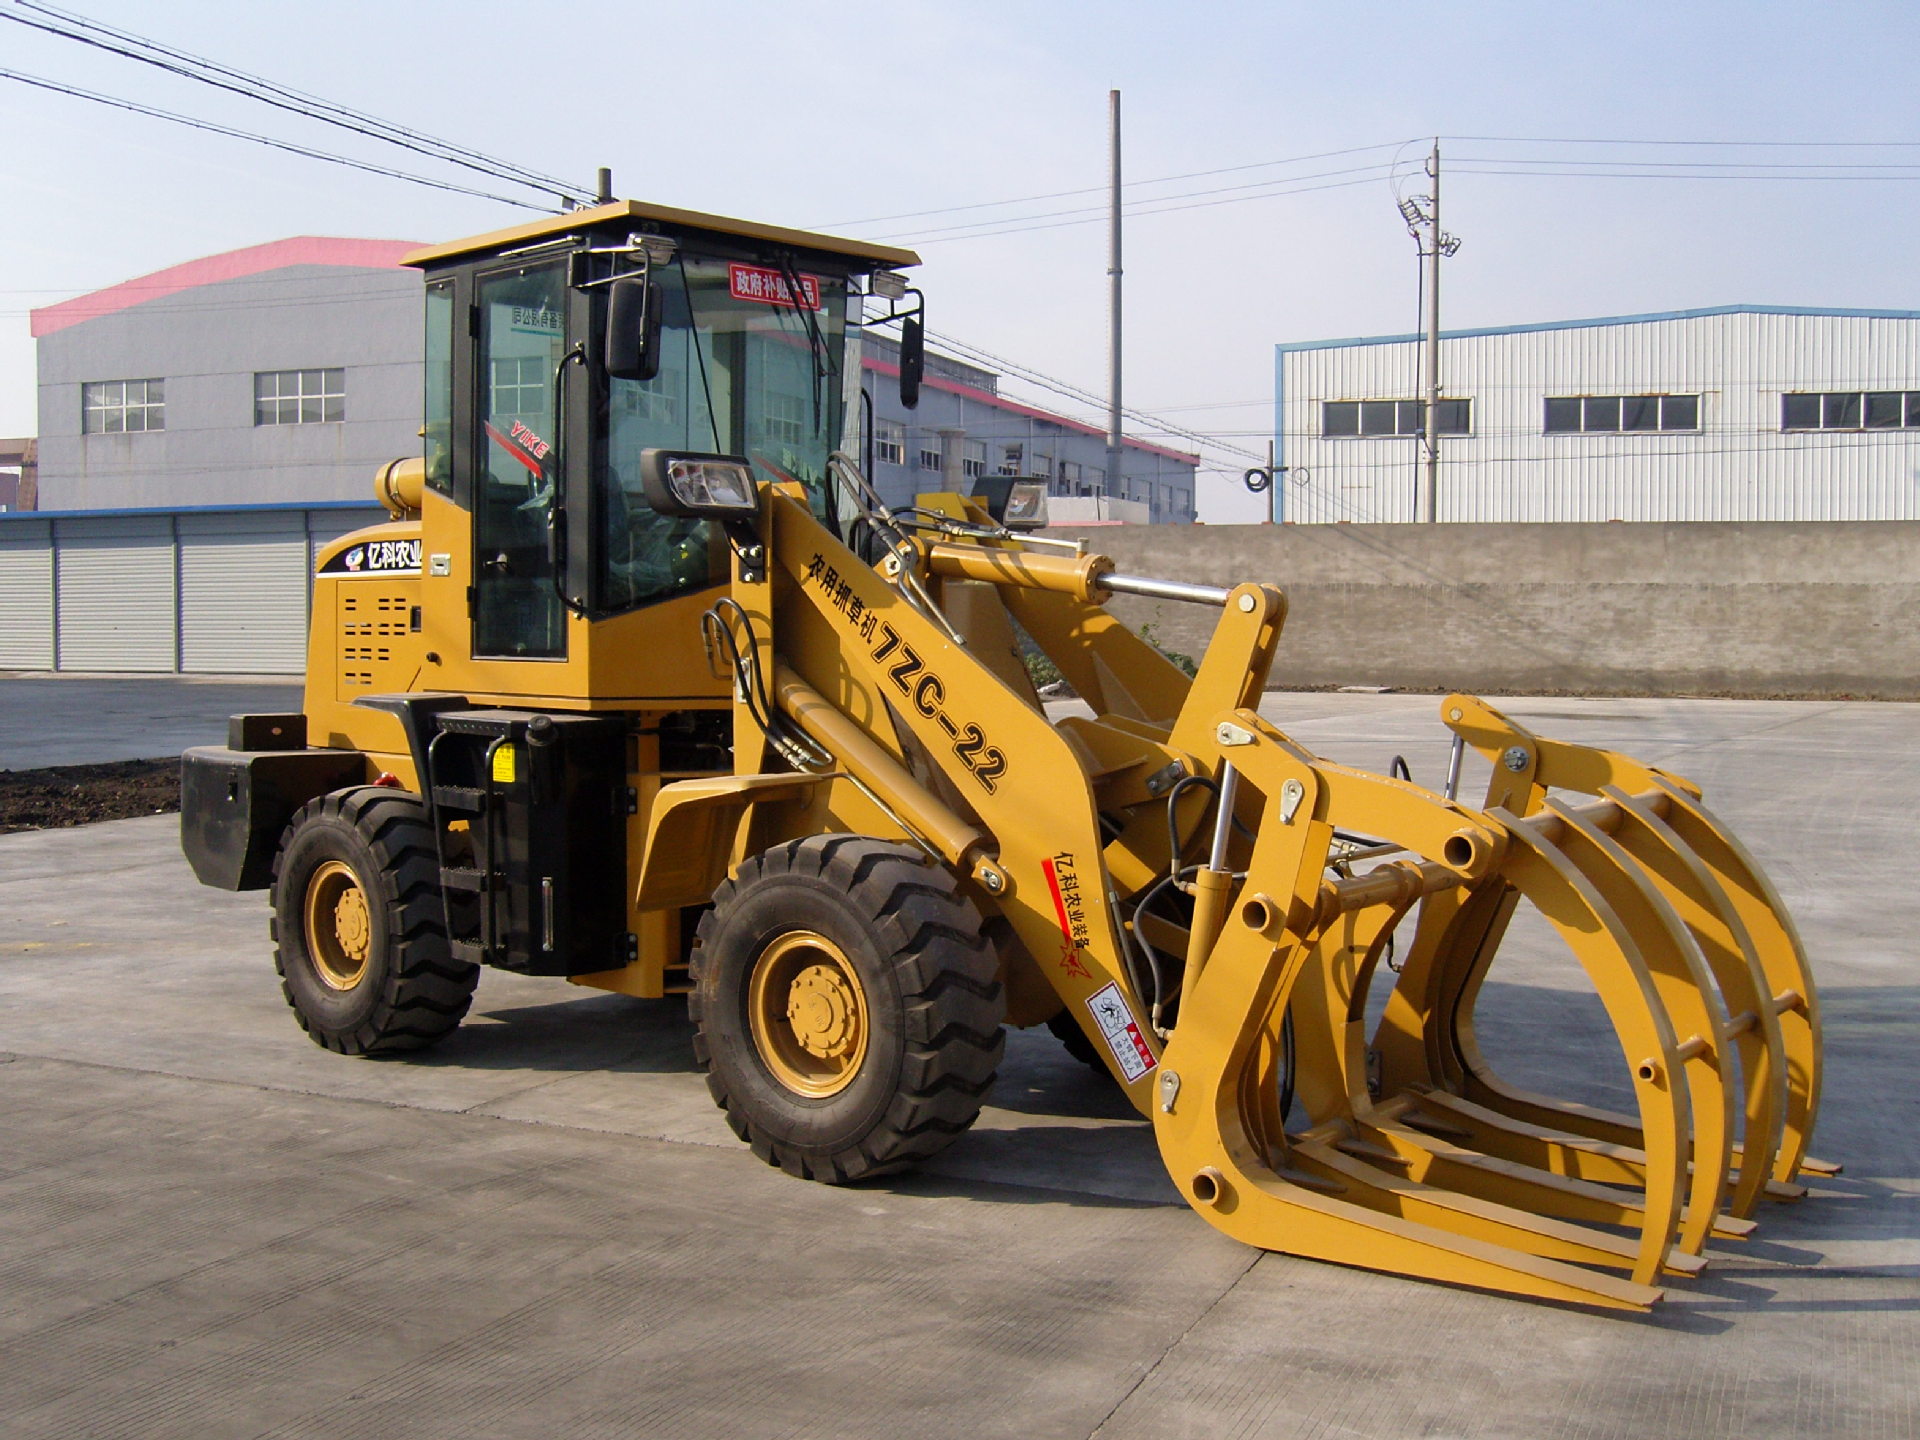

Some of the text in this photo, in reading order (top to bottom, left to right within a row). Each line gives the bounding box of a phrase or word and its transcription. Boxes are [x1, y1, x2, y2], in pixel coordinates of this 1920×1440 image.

[735, 270, 814, 304] 政府补贴品
[511, 420, 550, 460] YIKE
[368, 540, 422, 569] 亿科农业
[808, 552, 1007, 795] 农用抓草机 7ZC-22
[1054, 851, 1090, 949] 亿科农业装备
